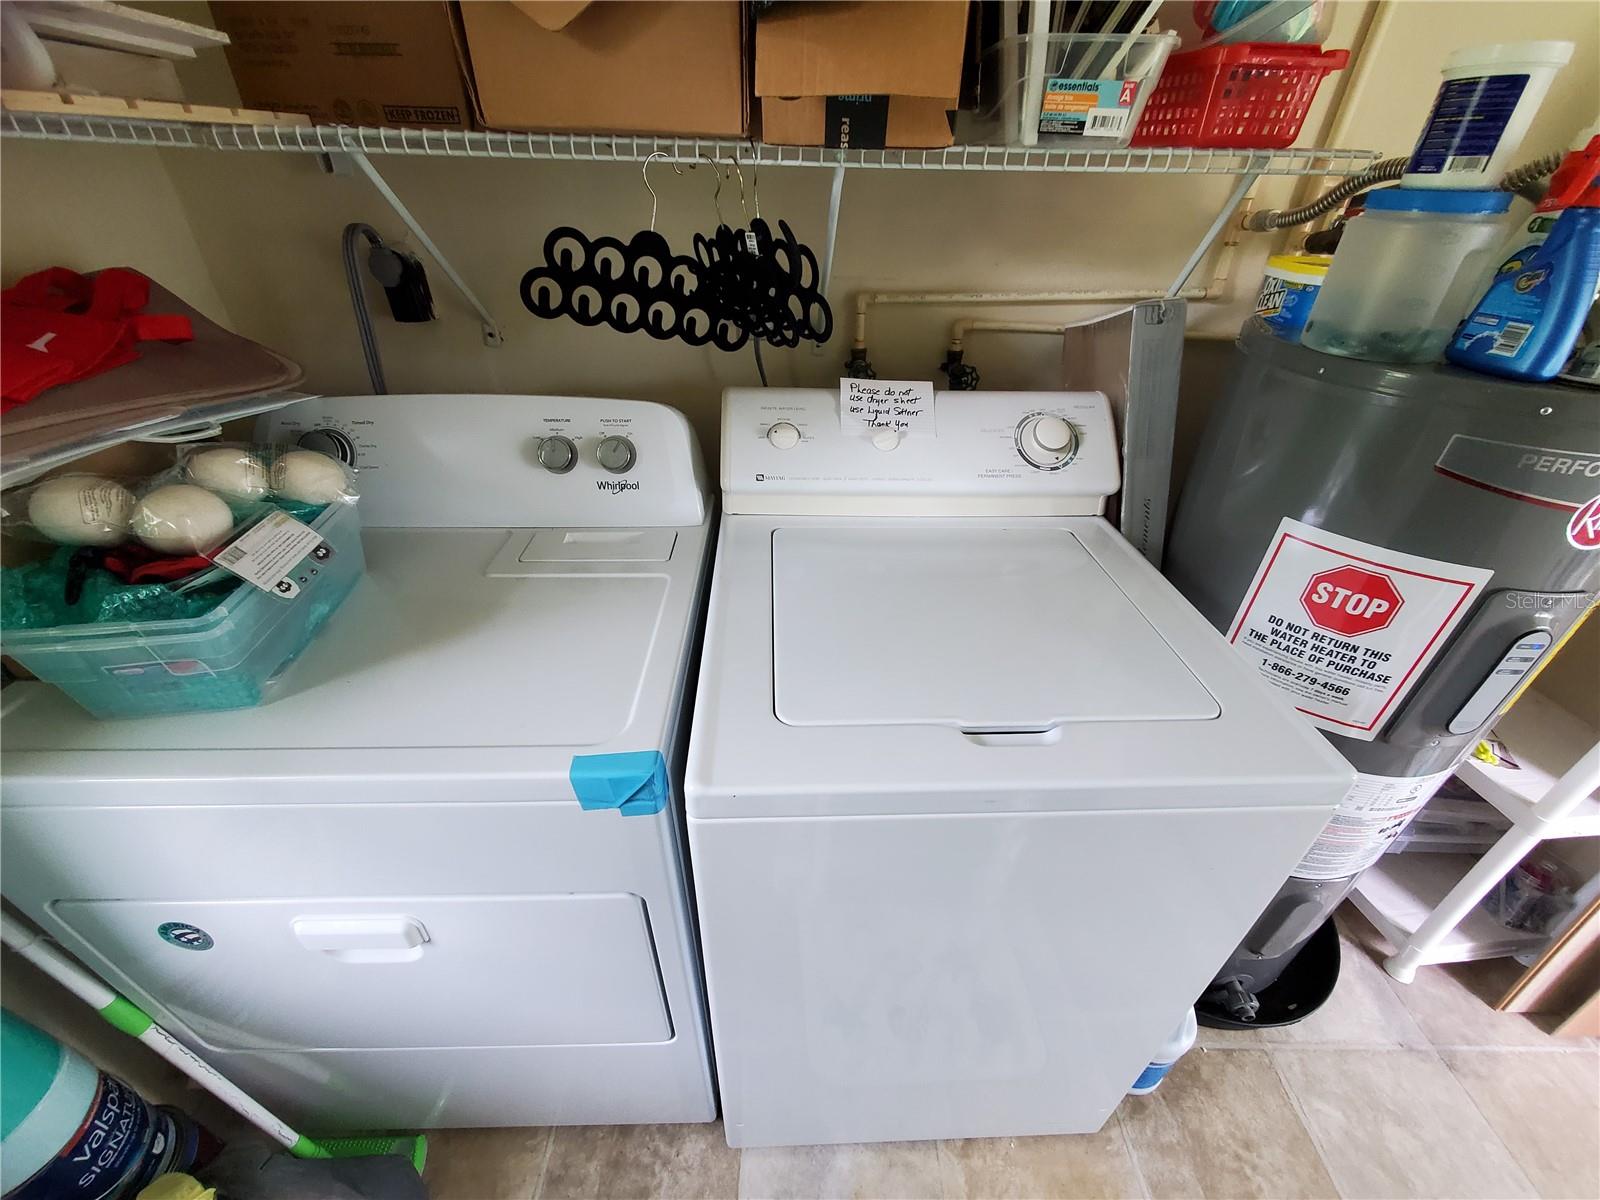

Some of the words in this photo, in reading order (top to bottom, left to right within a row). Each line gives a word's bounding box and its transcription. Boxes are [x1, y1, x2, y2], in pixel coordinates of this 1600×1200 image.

[1058, 81, 1099, 92] essentials
[1119, 87, 1131, 103] A
[413, 109, 456, 121] FROZEN
[850, 382, 880, 396] Please
[884, 387, 896, 396] do
[898, 388, 914, 396] not
[862, 419, 892, 428] Thank
[596, 480, 640, 494] Whirlpool
[1311, 582, 1390, 619] STOP
[1268, 614, 1284, 627] DO
[1287, 619, 1310, 635] NOT
[1311, 630, 1360, 654] RETURN
[1362, 646, 1393, 663] THIS
[1248, 628, 1269, 643] THE
[1270, 637, 1305, 659] PLACE
[1307, 652, 1325, 666] OF
[1326, 659, 1393, 684] PURCHASE
[1270, 627, 1309, 648] WATER
[1310, 641, 1357, 664] HEATER
[1360, 658, 1377, 670] TO
[1261, 658, 1351, 696] 1-866-279-4566
